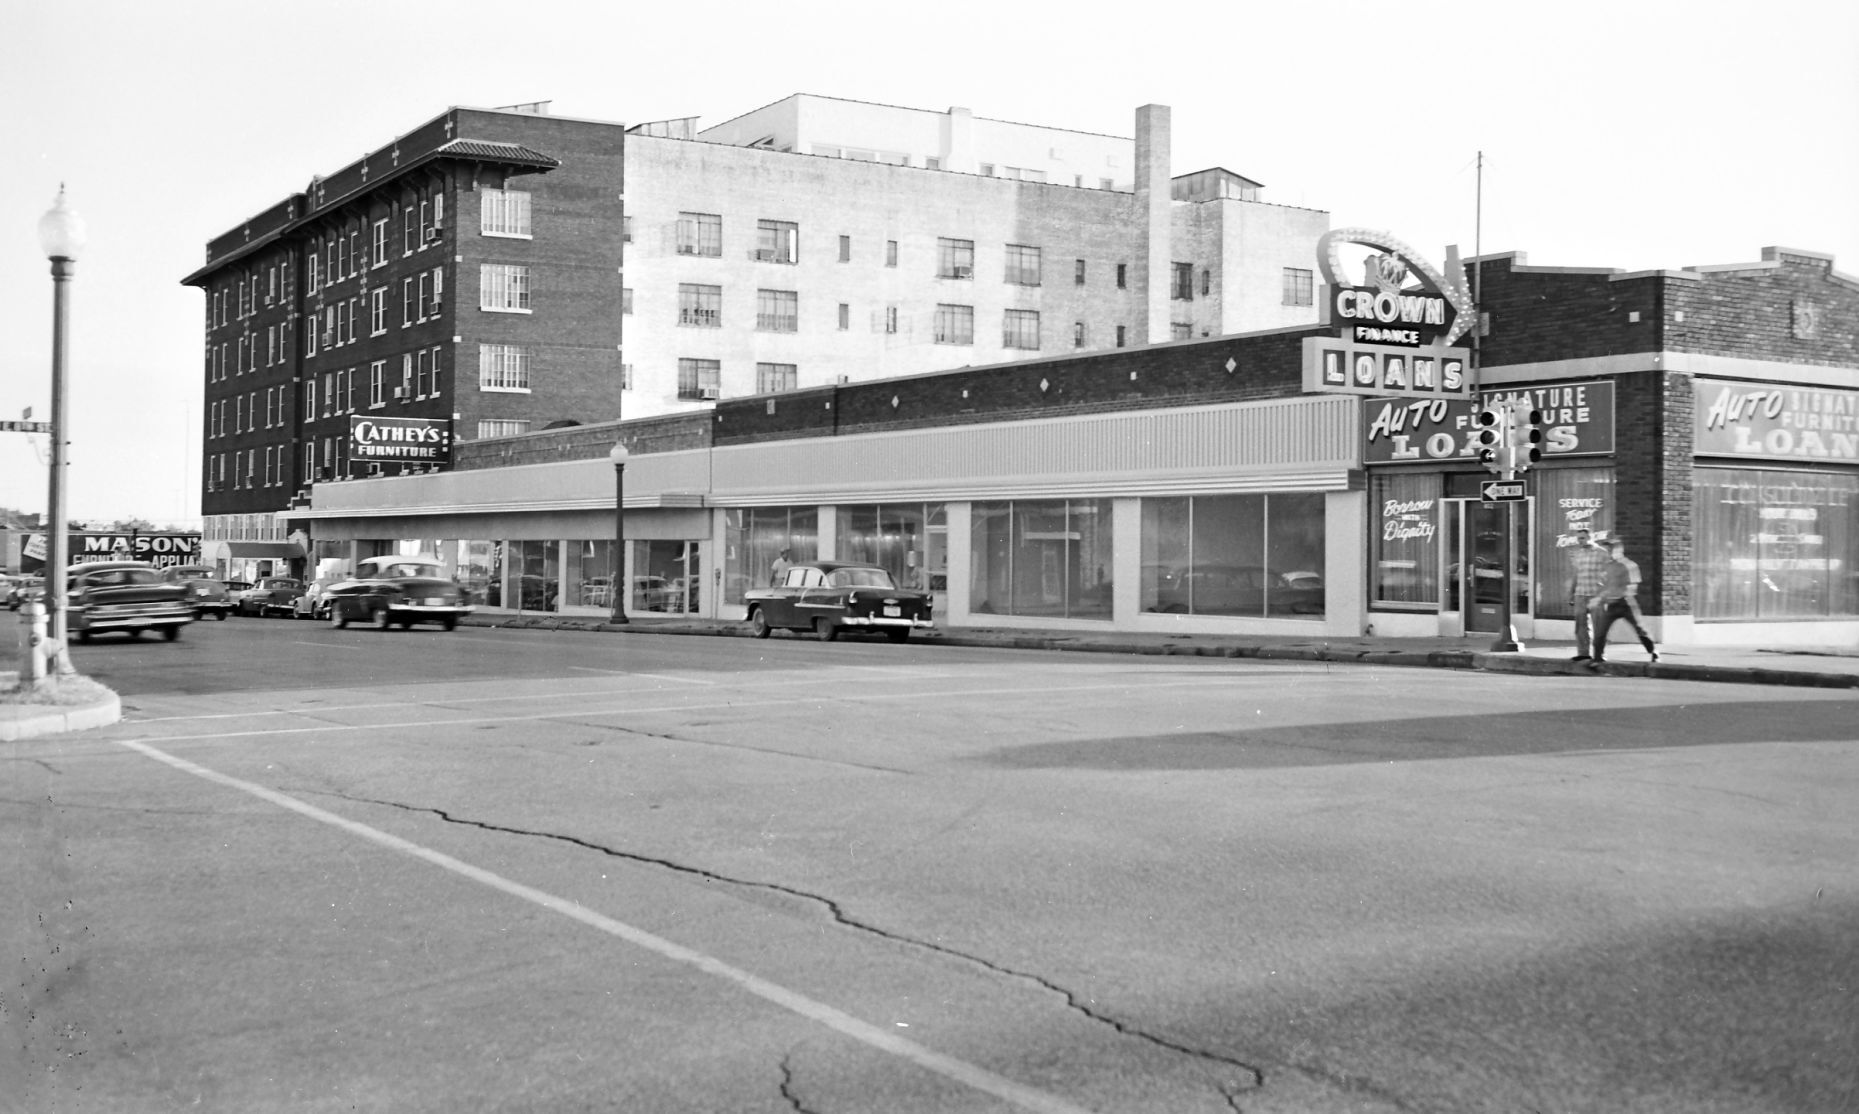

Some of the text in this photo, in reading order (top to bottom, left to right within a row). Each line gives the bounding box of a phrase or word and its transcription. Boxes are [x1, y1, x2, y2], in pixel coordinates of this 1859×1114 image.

[1337, 290, 1445, 325] CROWN
[1356, 326, 1420, 344] FINANCE
[1326, 353, 1462, 390] LOANS
[1707, 387, 1784, 429] AUTO
[1368, 399, 1448, 441] AUTO
[354, 421, 440, 445] CATHEY'S
[1391, 425, 1579, 459] LOAS
[358, 445, 437, 457] FURNITURE
[1383, 500, 1433, 516] Borrow
[1558, 498, 1604, 508] SERVICE
[1383, 521, 1436, 543] Dignity
[1569, 522, 1591, 530] NOT
[84, 536, 203, 552] MASON'
